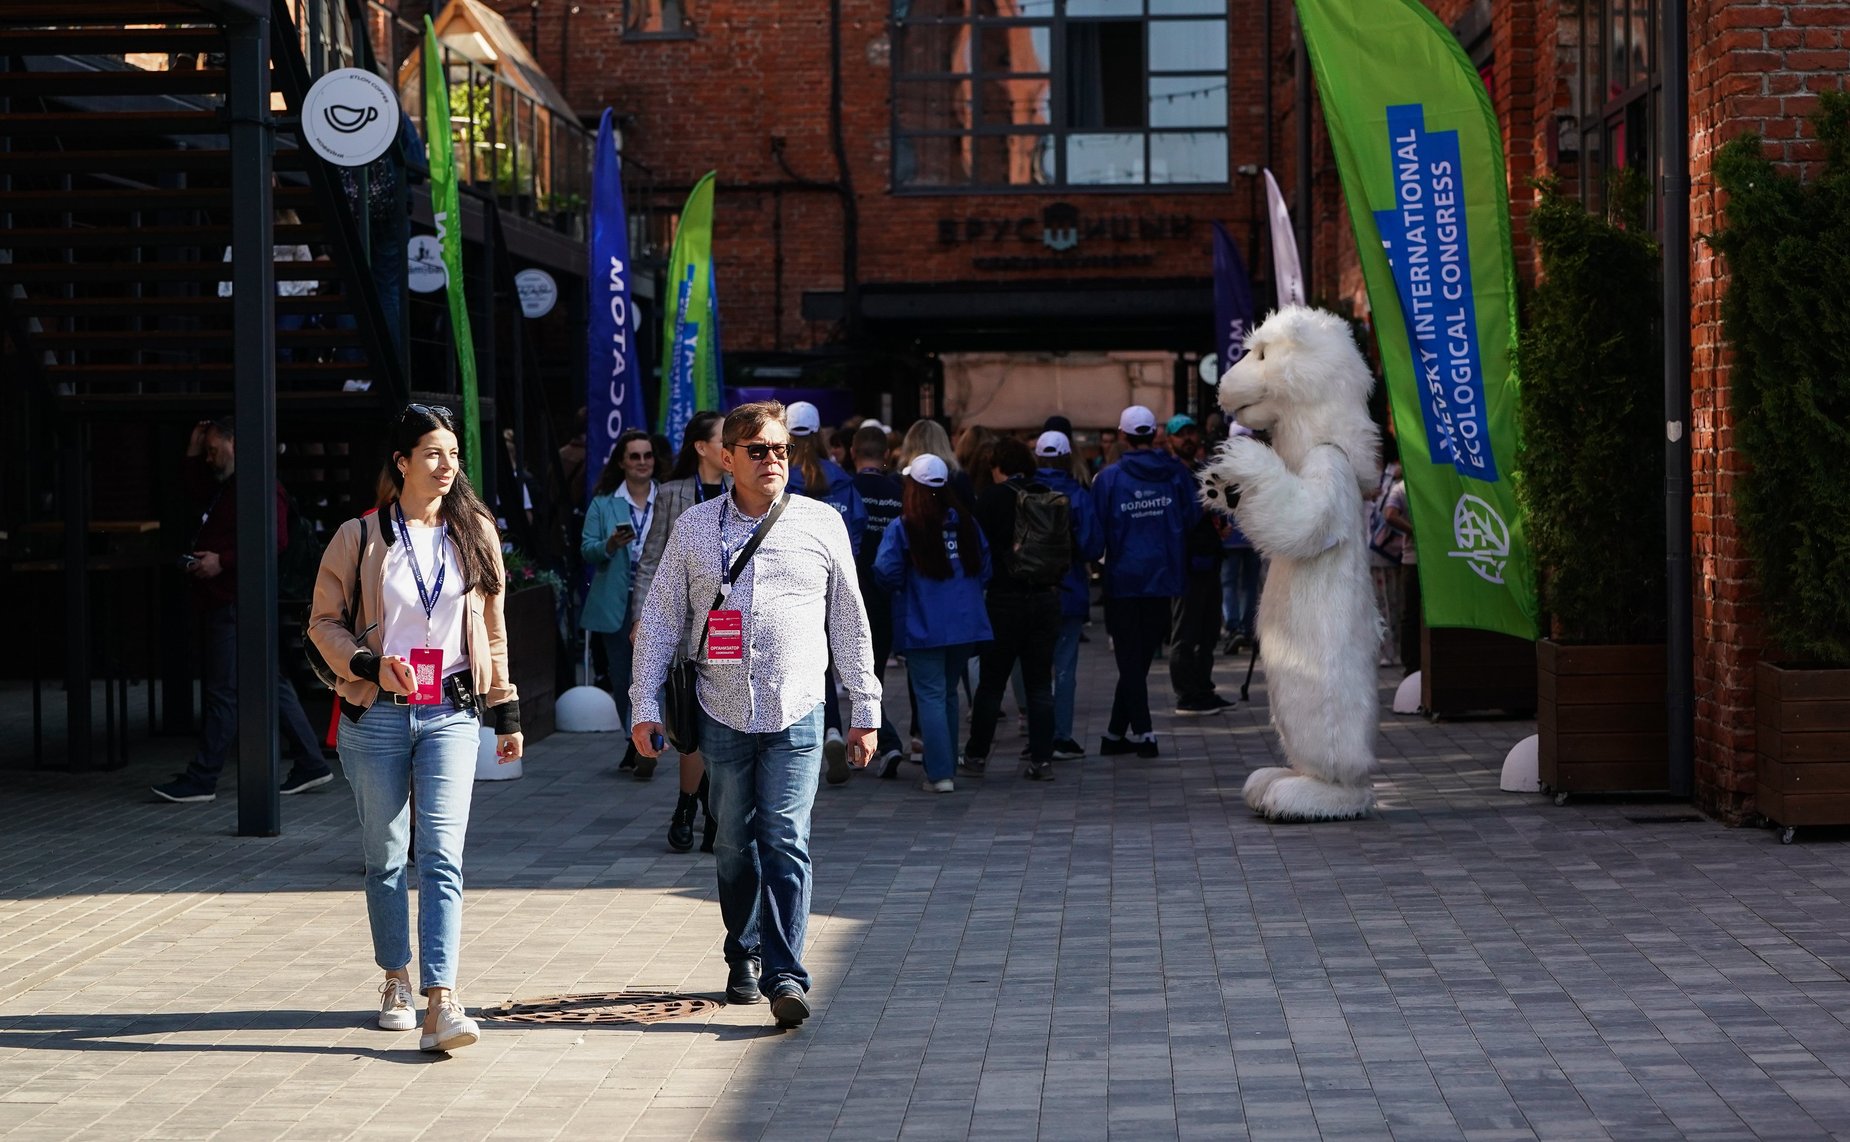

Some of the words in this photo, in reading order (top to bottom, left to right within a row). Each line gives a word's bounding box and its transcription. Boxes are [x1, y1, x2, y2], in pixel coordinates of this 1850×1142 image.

[1395, 128, 1435, 340] INTERNATIONAL
[1430, 160, 1463, 300] CONGRESS
[1445, 308, 1485, 469] ECOLOGICAL
[1120, 496, 1172, 512] ВОЛОНТЁР
